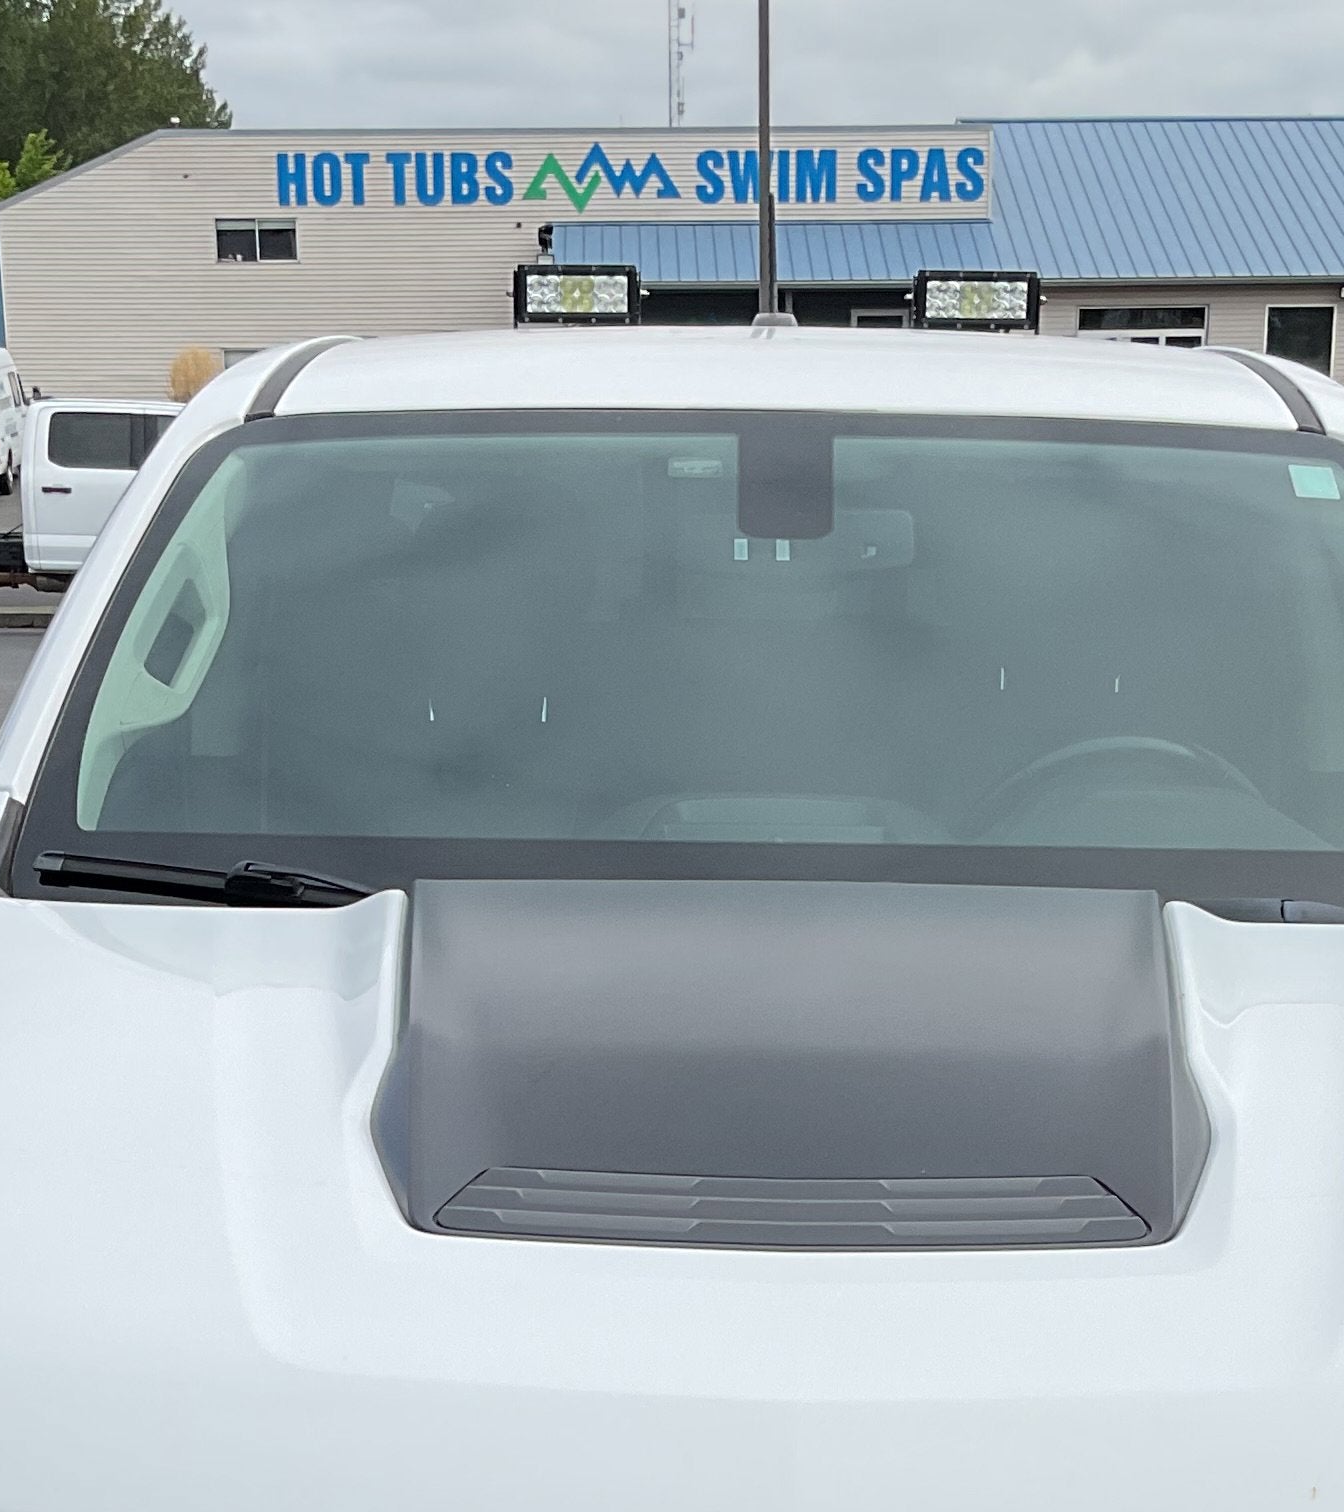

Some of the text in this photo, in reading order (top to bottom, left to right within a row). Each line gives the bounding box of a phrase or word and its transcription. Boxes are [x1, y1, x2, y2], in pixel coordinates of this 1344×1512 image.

[276, 146, 985, 207] HOT TUBS SWIM SPAS
